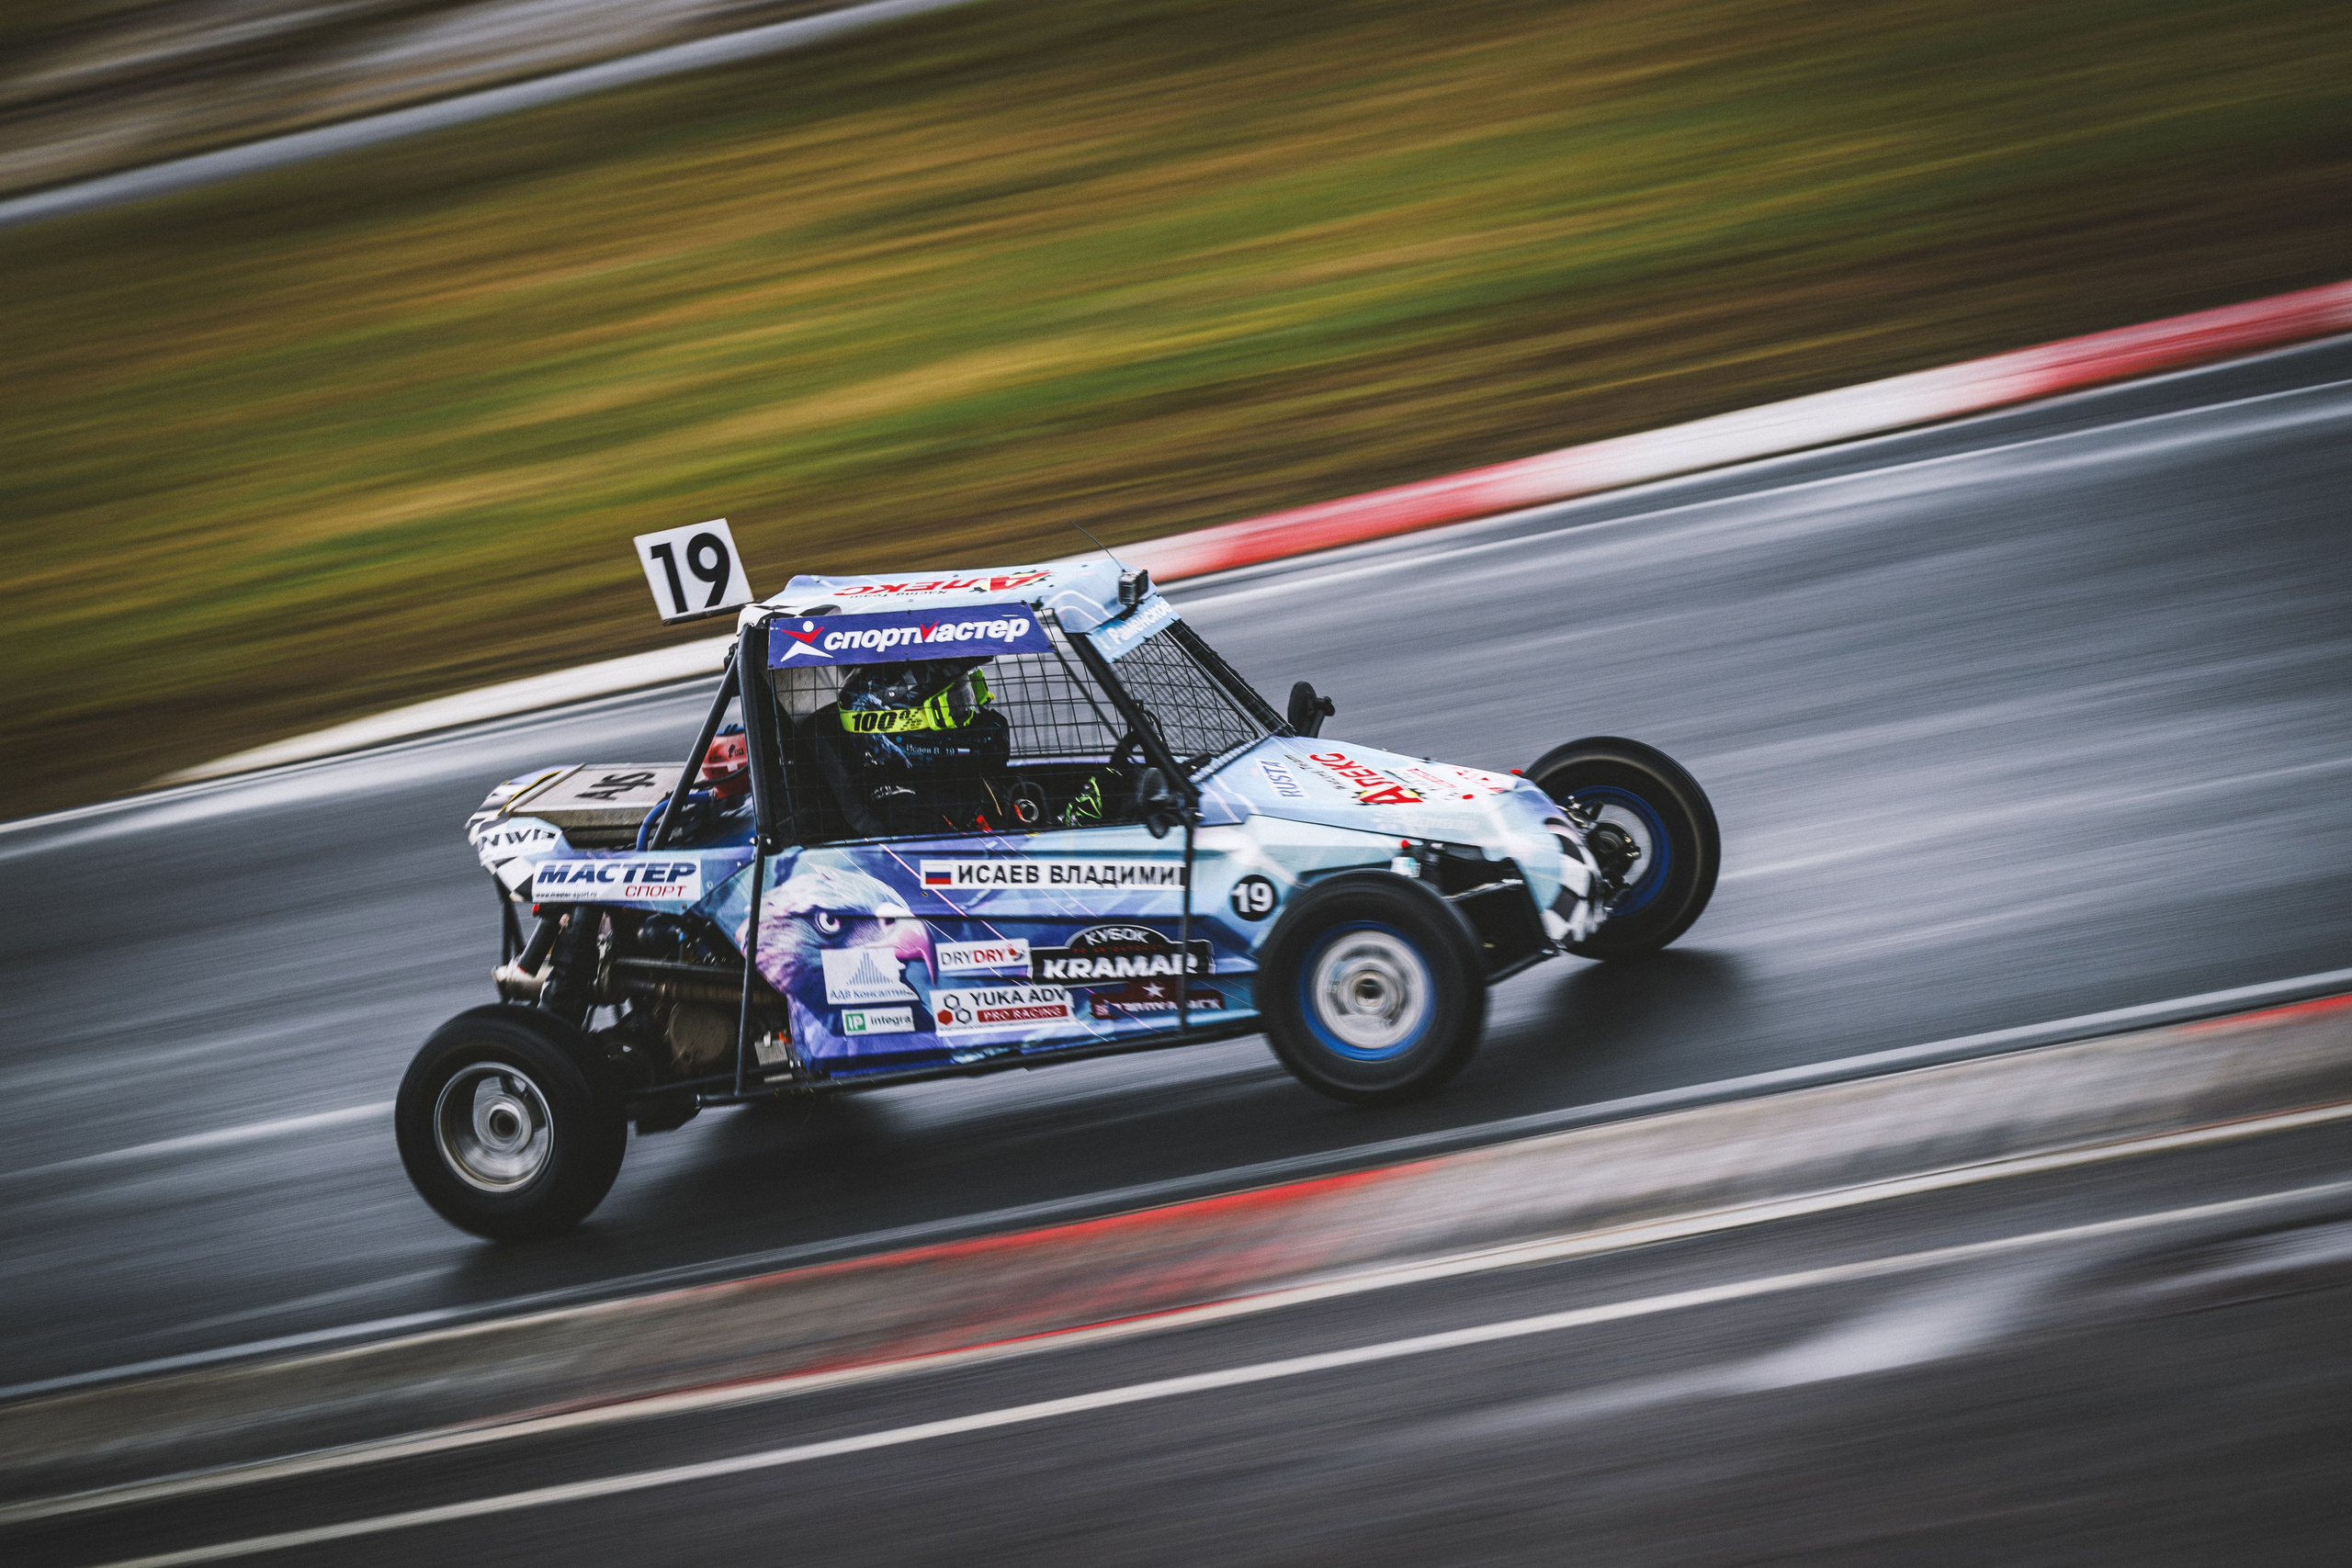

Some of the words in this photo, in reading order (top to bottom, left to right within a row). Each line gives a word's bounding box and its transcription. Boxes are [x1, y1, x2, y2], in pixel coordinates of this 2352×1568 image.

[650, 533, 730, 615] 19
[1106, 600, 1172, 645] Раменское
[852, 709, 922, 731] 100%
[1260, 760, 1303, 797] RUSTA
[537, 862, 697, 884] МАСТЕР
[957, 863, 1040, 885] ИСАЕВ
[1050, 863, 1185, 886] ВЛАДИМИ
[625, 885, 687, 897] СПОРТ
[1232, 883, 1272, 912] 19
[1043, 953, 1198, 979] KRAMAR
[970, 988, 1025, 1007] YUKA
[870, 1014, 911, 1026] integra
[984, 1010, 1011, 1021] PRO
[1012, 1005, 1062, 1020] RACING
